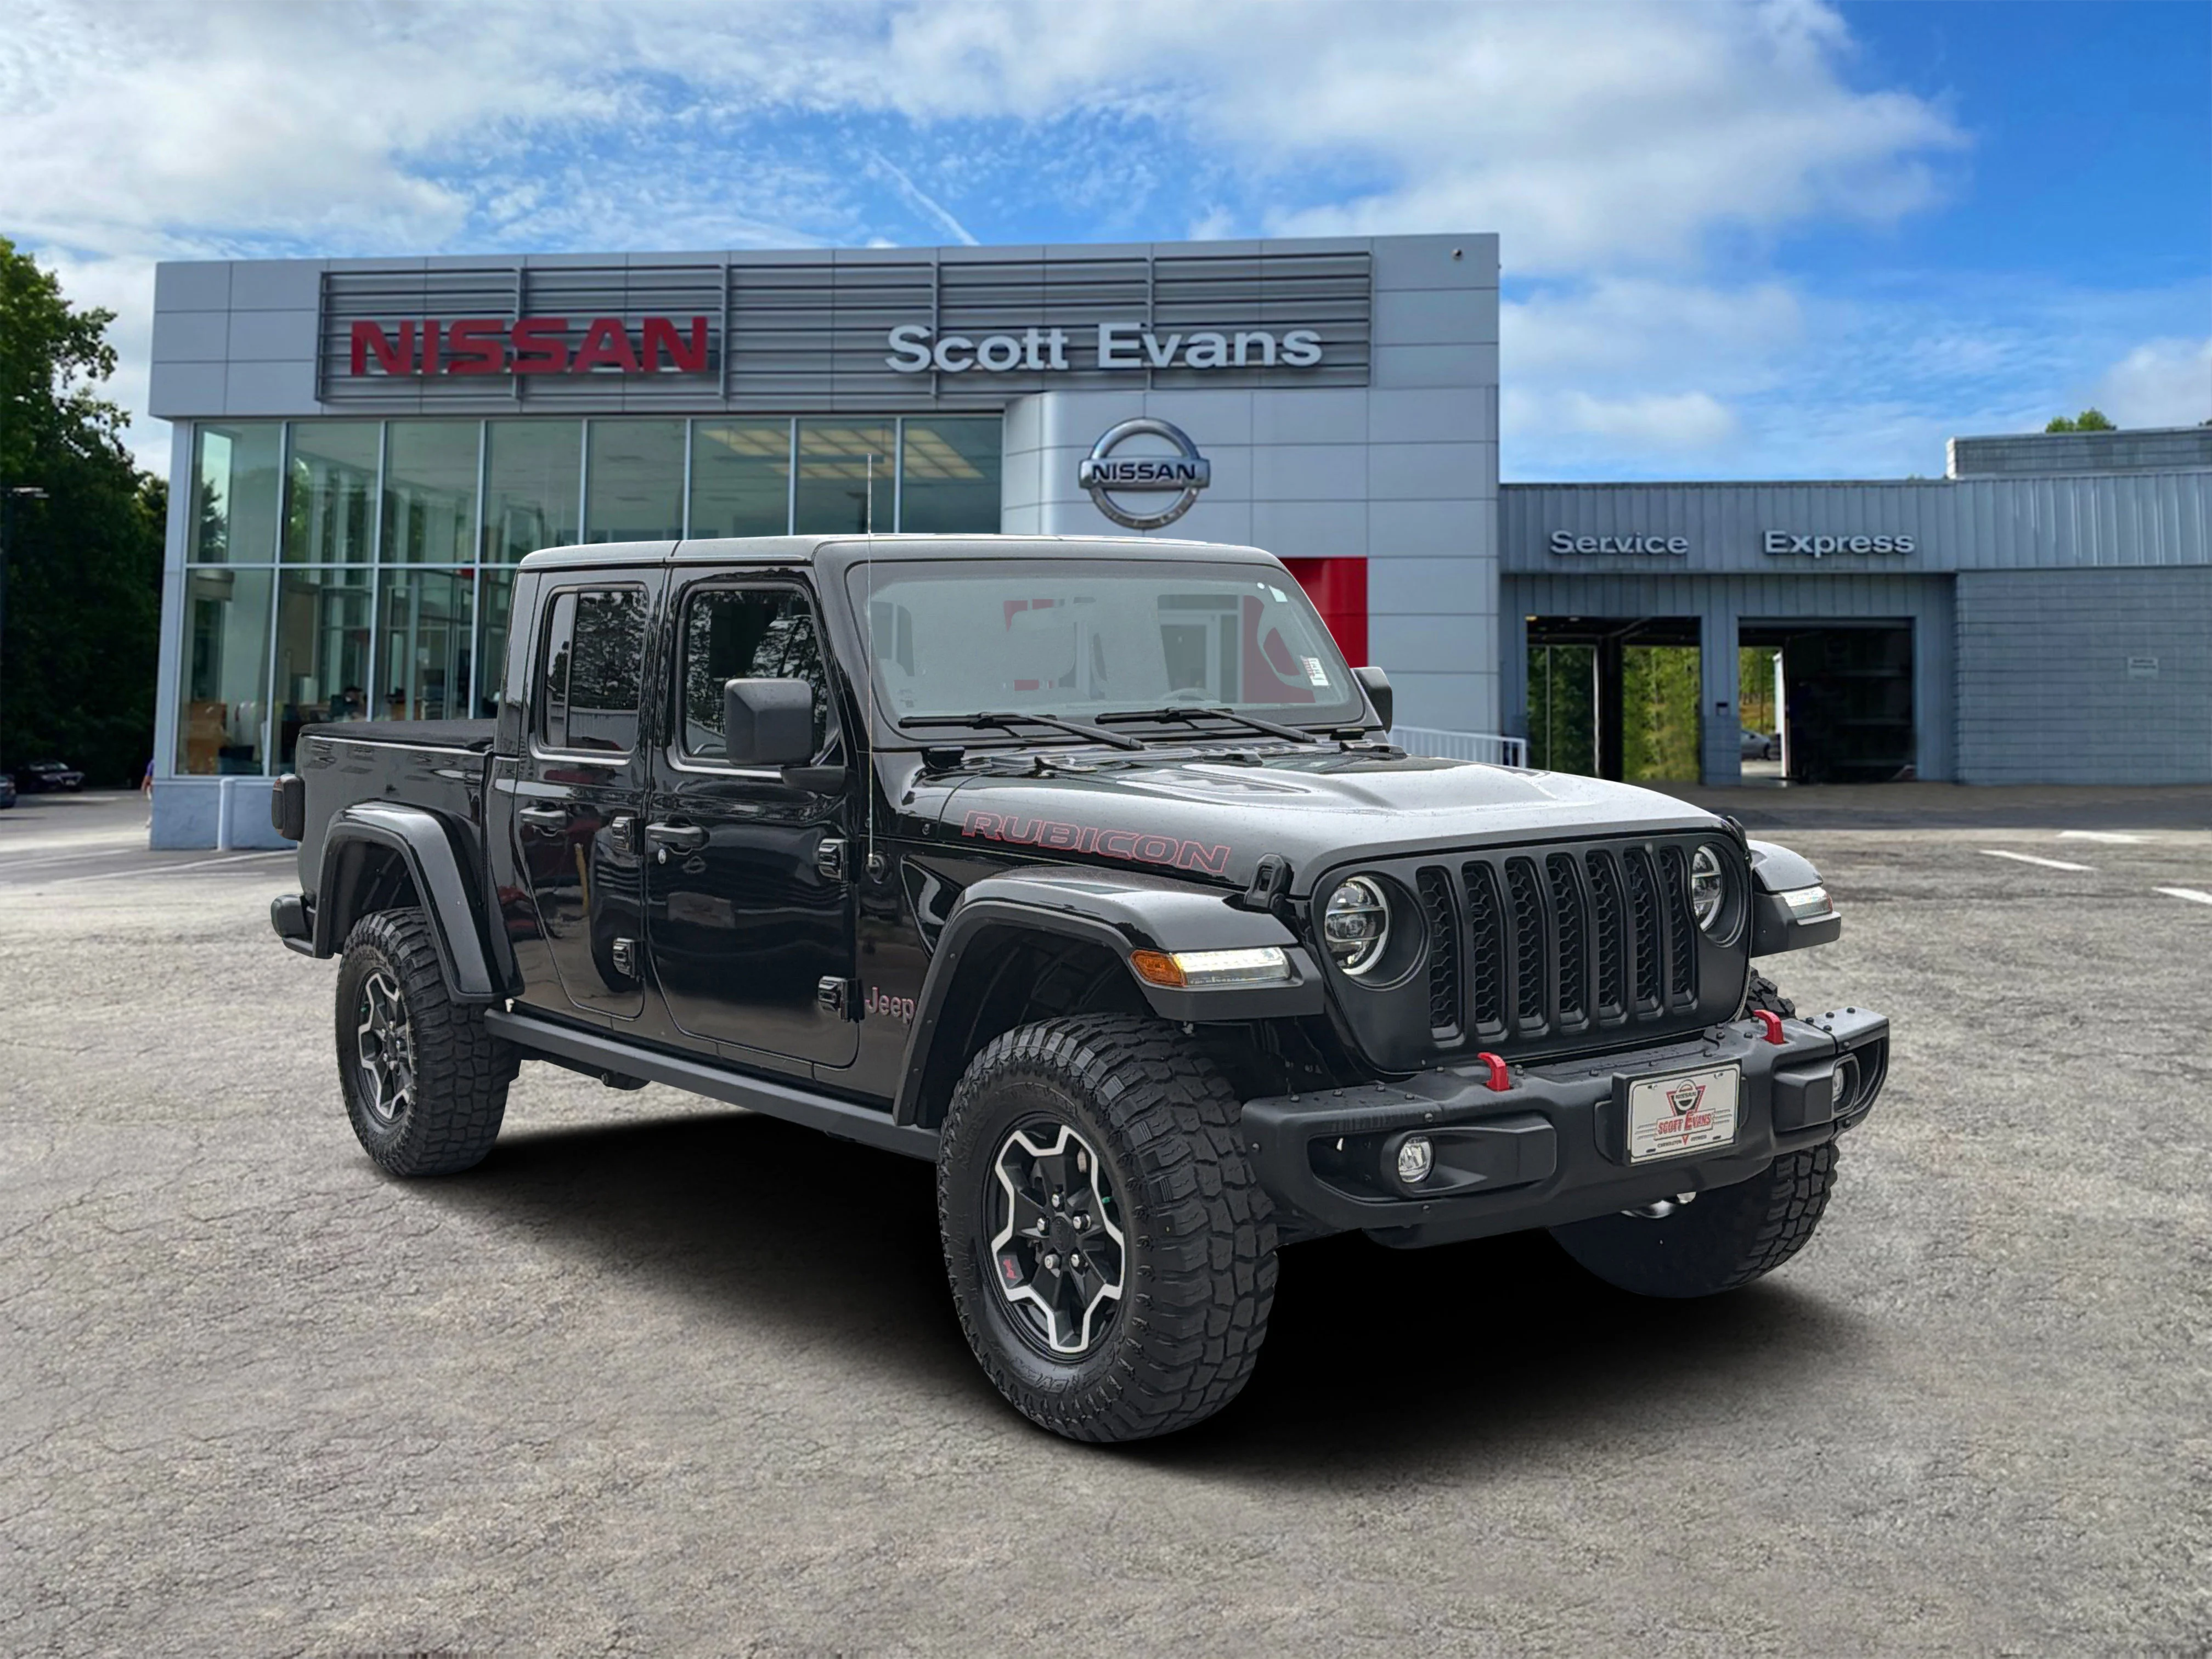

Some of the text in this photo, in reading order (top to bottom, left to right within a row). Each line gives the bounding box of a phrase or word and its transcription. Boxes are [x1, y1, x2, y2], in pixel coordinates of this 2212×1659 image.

[351, 317, 708, 375] NISSAN
[885, 323, 1323, 373] Scott Evans
[1092, 464, 1195, 481] NISSAN
[1550, 530, 1915, 558] Service Express
[962, 810, 1231, 873] RUBICON
[864, 986, 915, 1025] Jeep
[1658, 1119, 1683, 1135] SCOTT
